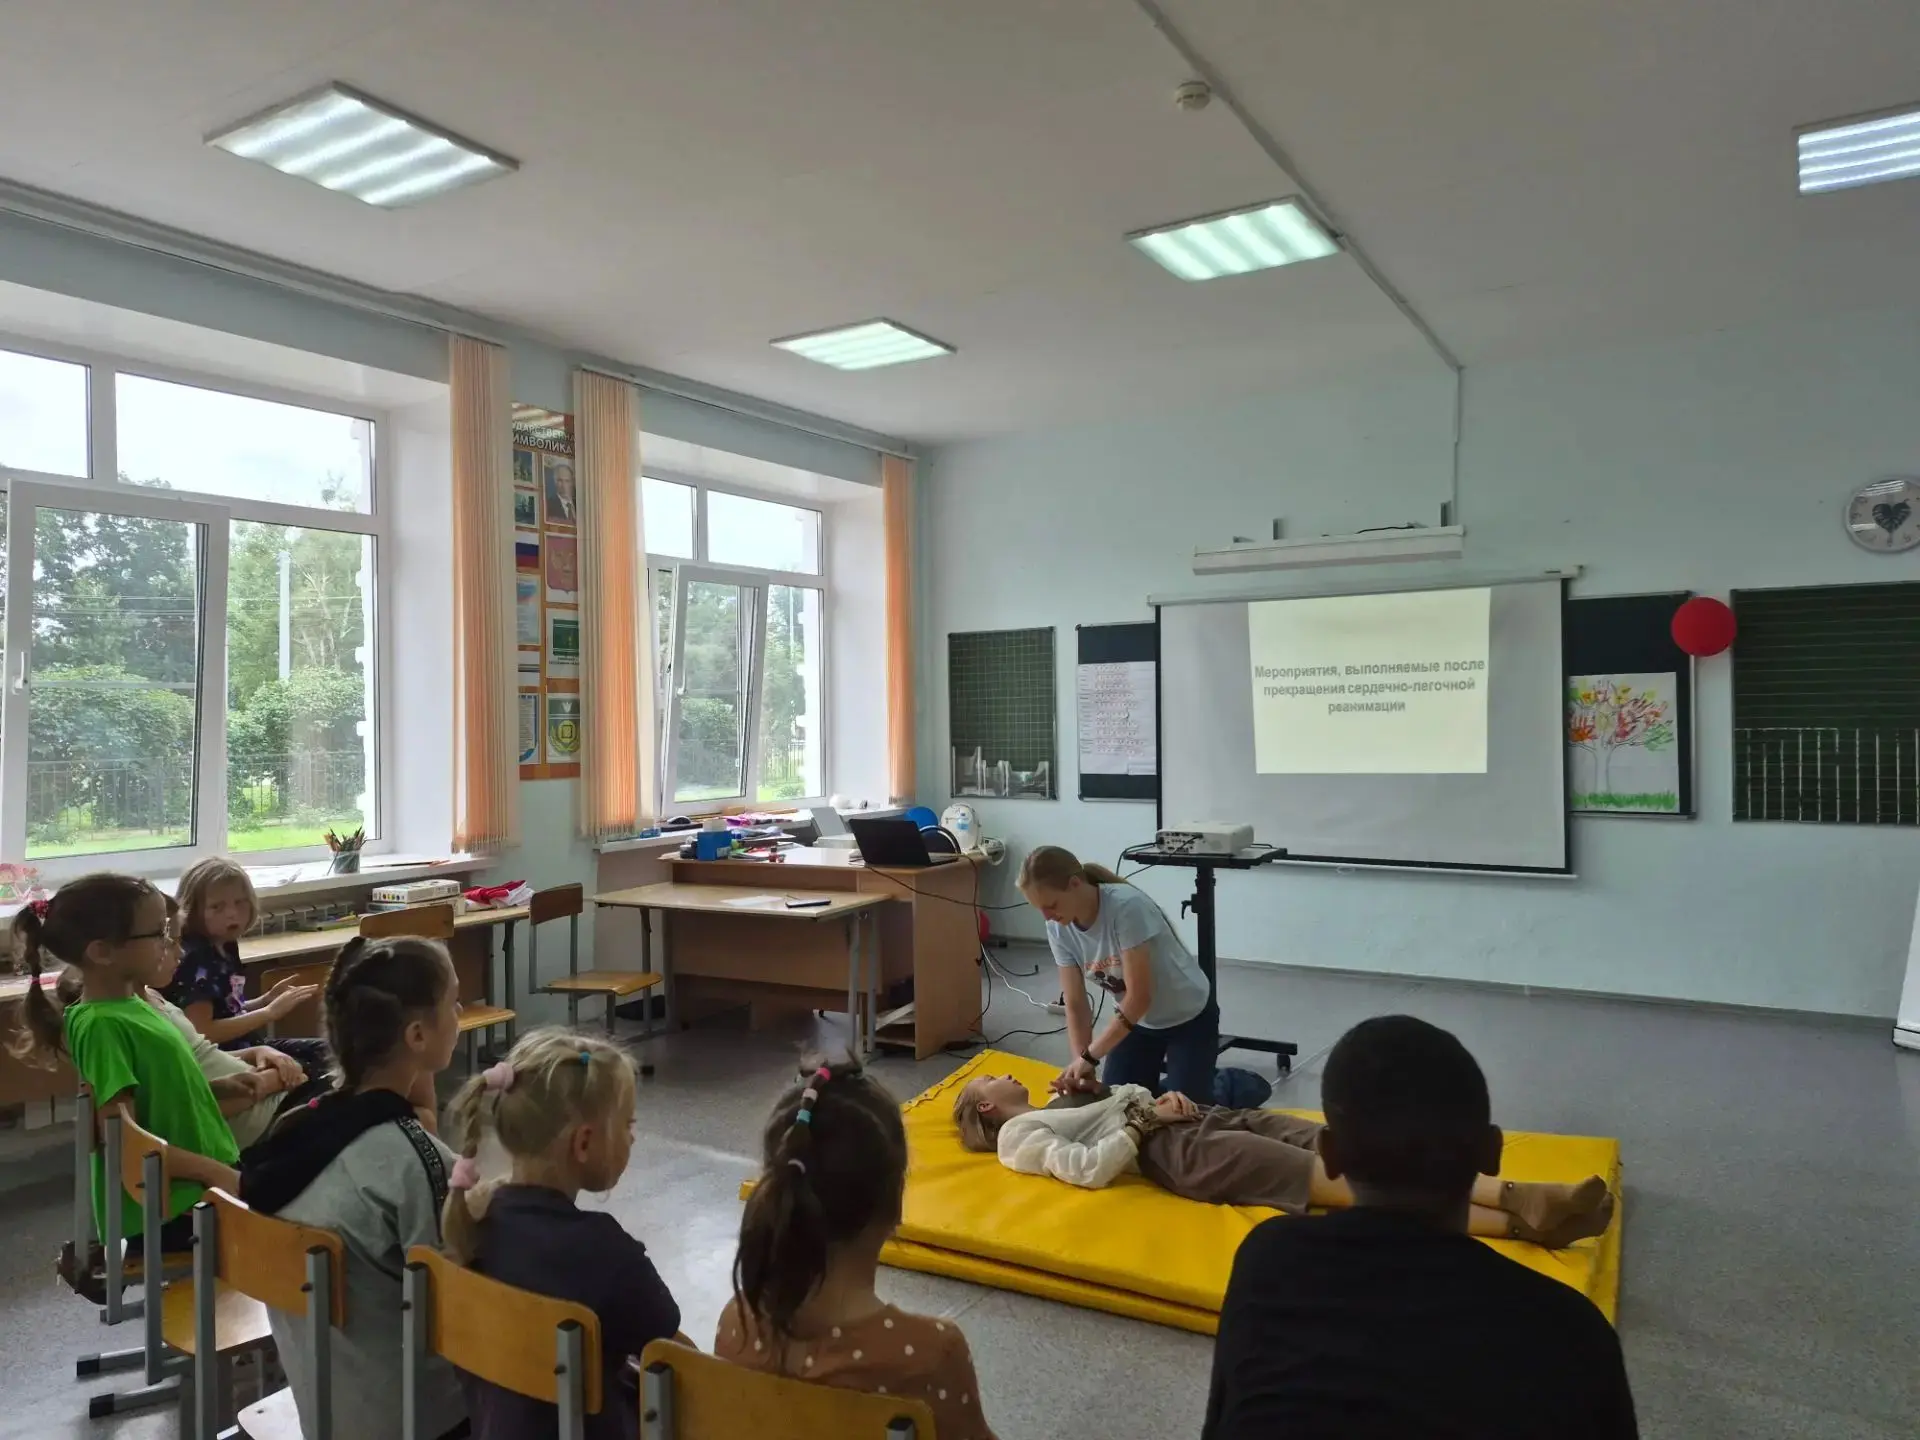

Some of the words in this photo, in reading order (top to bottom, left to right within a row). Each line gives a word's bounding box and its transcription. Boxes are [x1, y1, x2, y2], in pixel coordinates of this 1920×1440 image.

[1254, 665, 1341, 680] Мероприятия,
[1344, 662, 1440, 676] выполняемые
[1444, 659, 1485, 673] после
[1263, 684, 1345, 698] прекращения
[1328, 701, 1406, 715] реанимации
